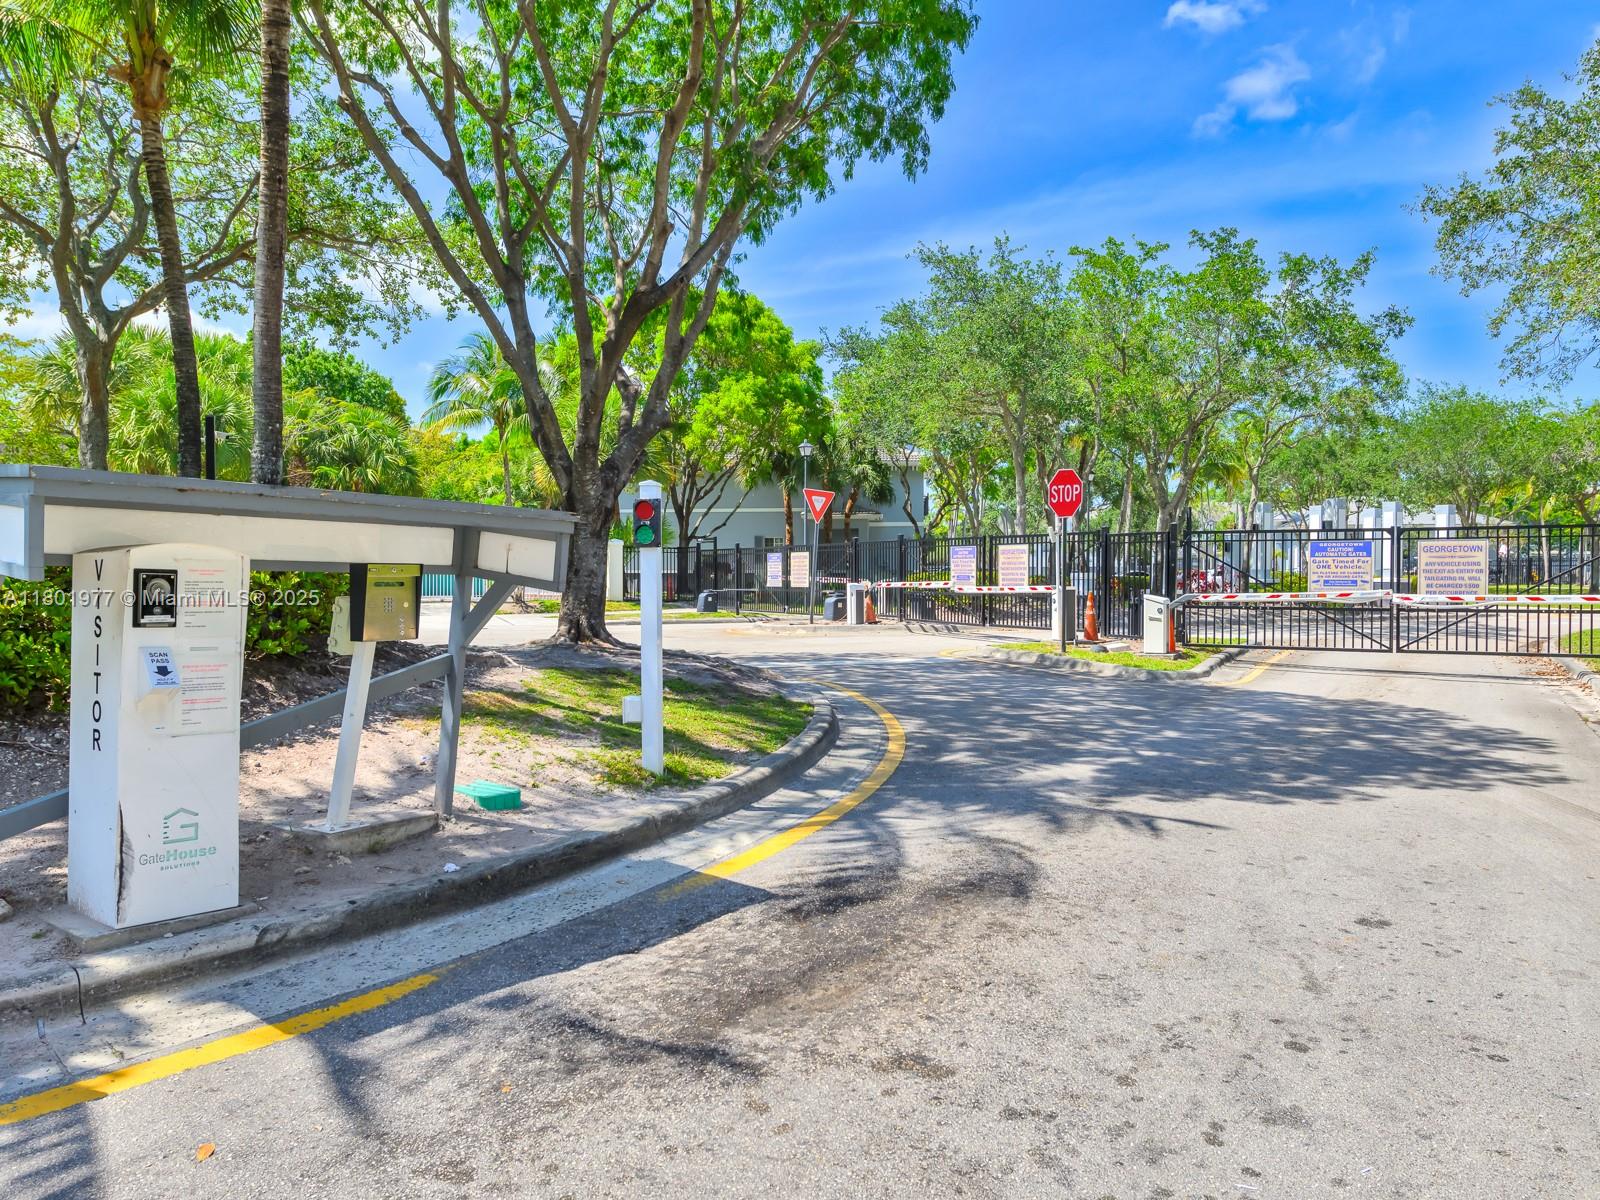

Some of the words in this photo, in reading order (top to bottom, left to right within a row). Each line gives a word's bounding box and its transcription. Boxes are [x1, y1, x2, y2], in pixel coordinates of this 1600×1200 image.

[1051, 484, 1080, 503] STOP
[92, 559, 103, 751] VISITOR
[139, 846, 217, 866] GateHouse
[160, 861, 200, 871] SOLUTIONS
